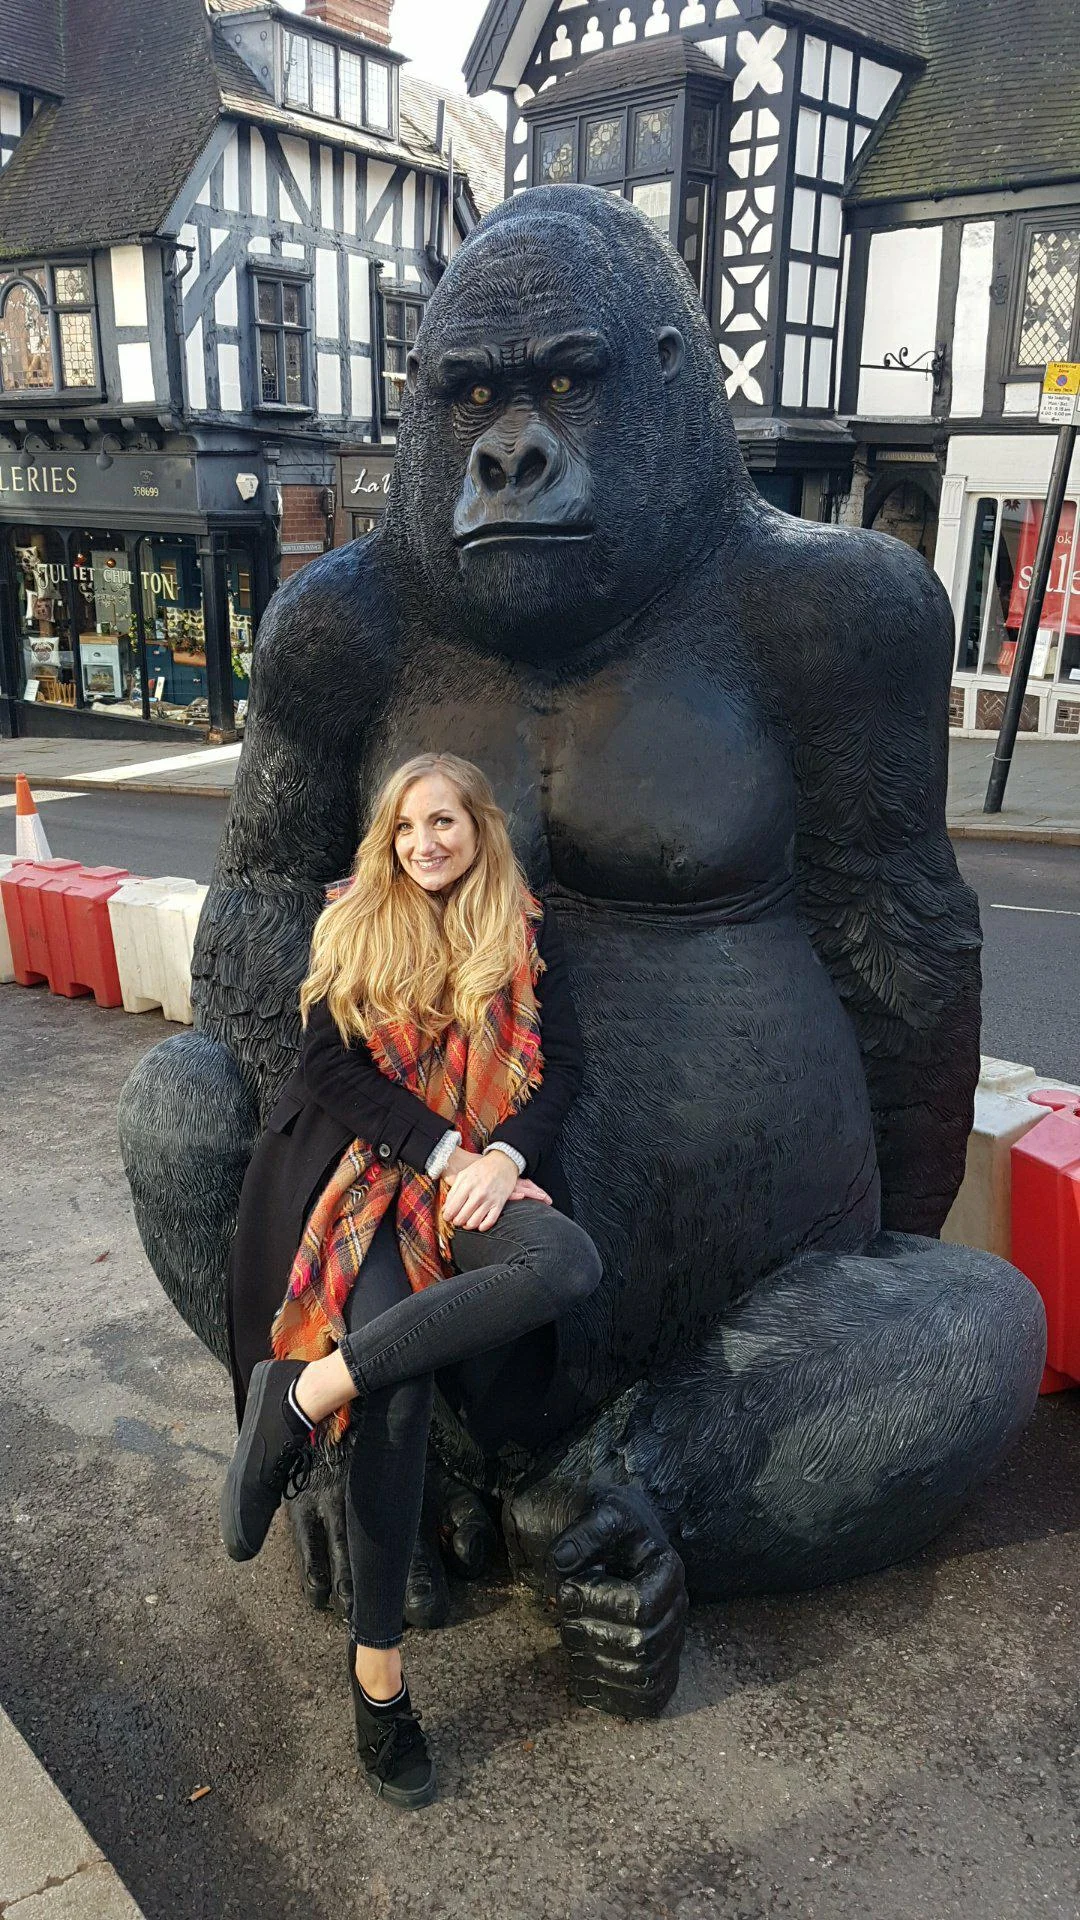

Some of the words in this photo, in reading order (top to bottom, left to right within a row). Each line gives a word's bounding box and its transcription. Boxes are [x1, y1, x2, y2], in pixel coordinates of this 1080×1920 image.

[0, 466, 78, 493] LERIES
[350, 468, 380, 494] La
[1018, 554, 1080, 595] sle
